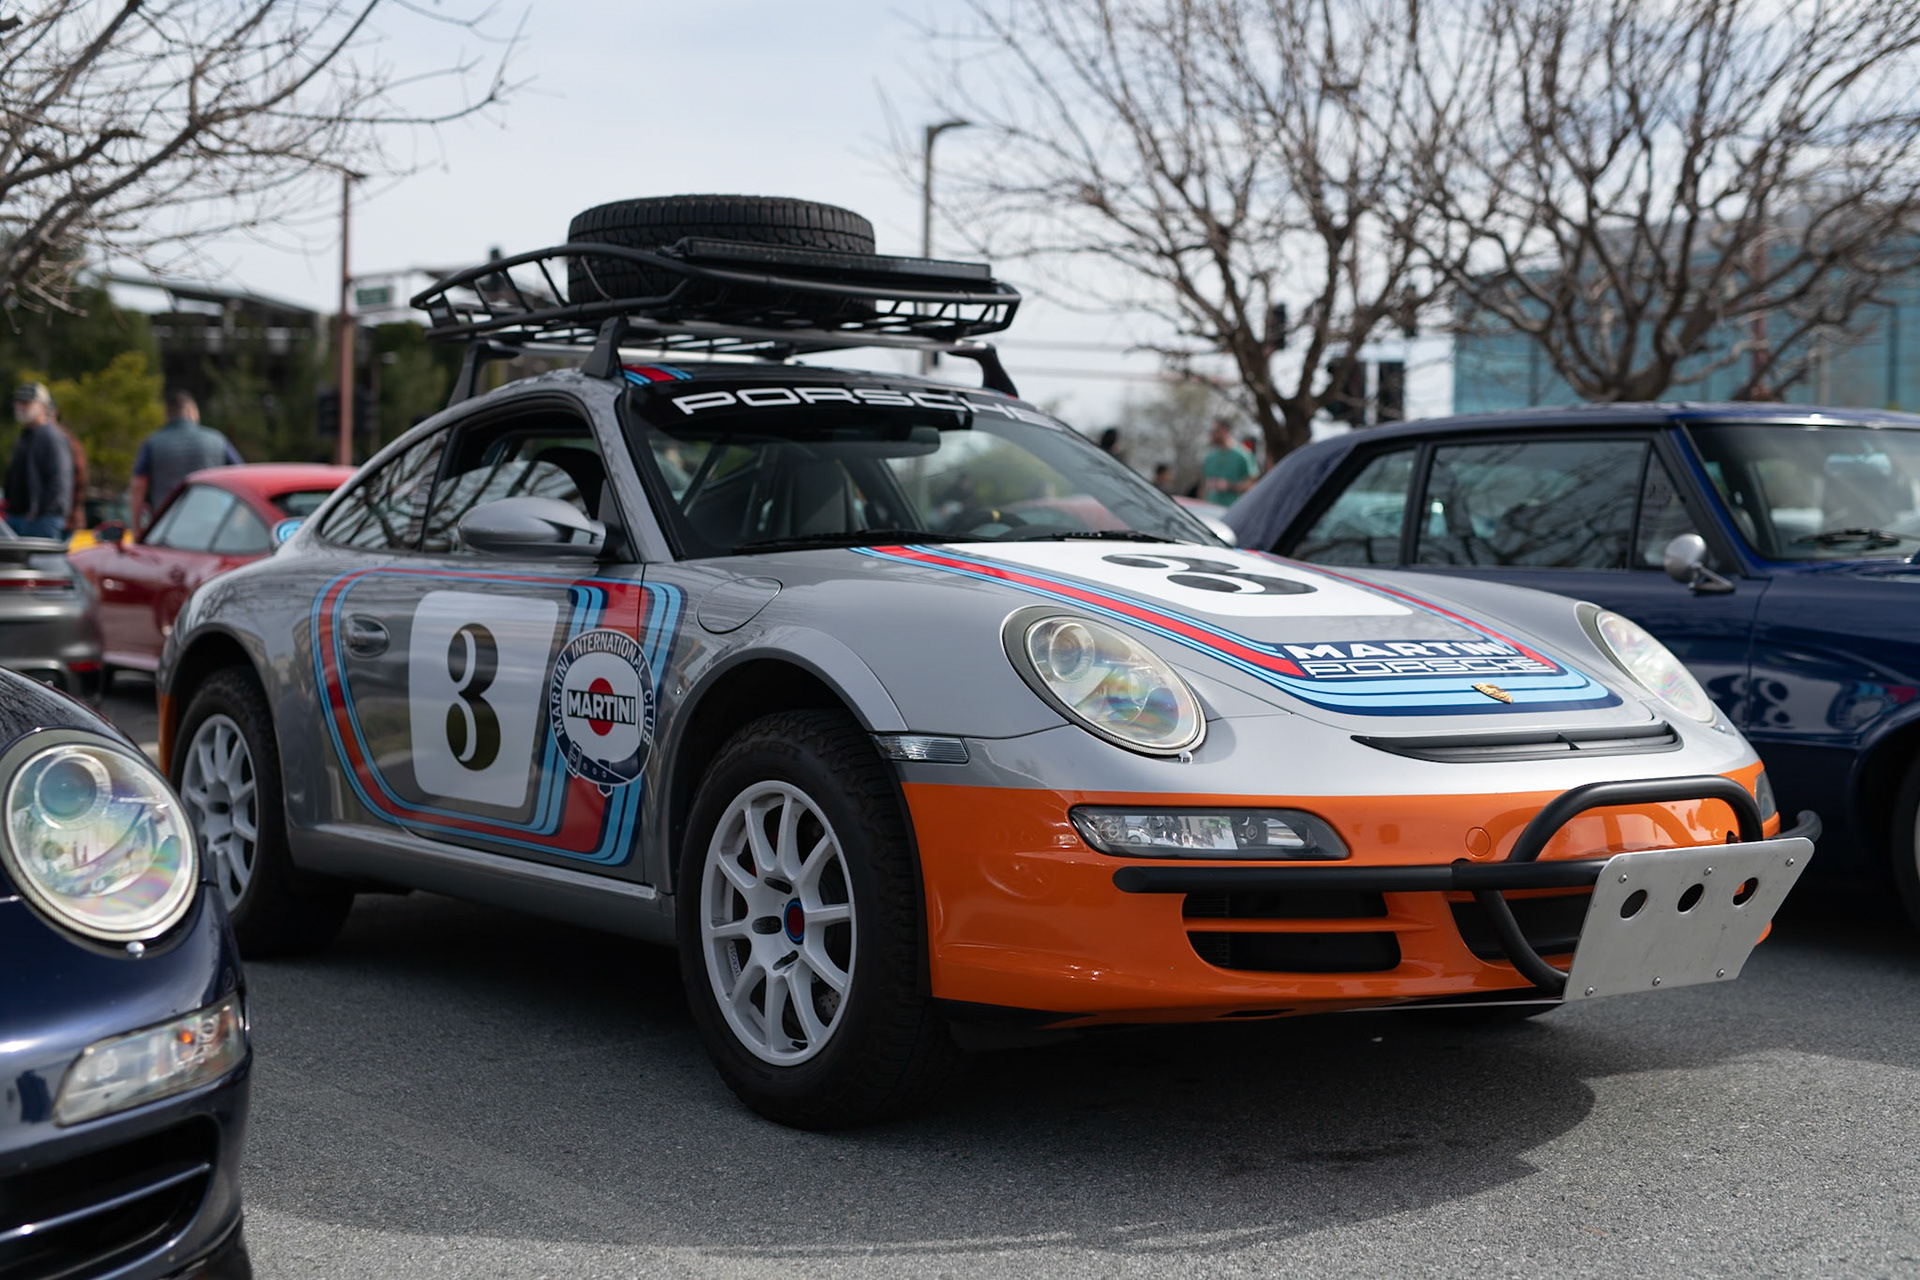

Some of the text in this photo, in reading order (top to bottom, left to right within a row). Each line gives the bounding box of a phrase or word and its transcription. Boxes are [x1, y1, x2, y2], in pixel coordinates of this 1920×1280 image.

[671, 387, 1063, 431] PORSCHE
[1102, 554, 1318, 595] 3
[1283, 641, 1516, 659] MARTINI
[1301, 659, 1551, 676] PORSCHE
[446, 622, 501, 771] 3
[551, 633, 654, 746] MARTINI INTERNATIONAL CLUB
[567, 691, 636, 724] MARTINI
